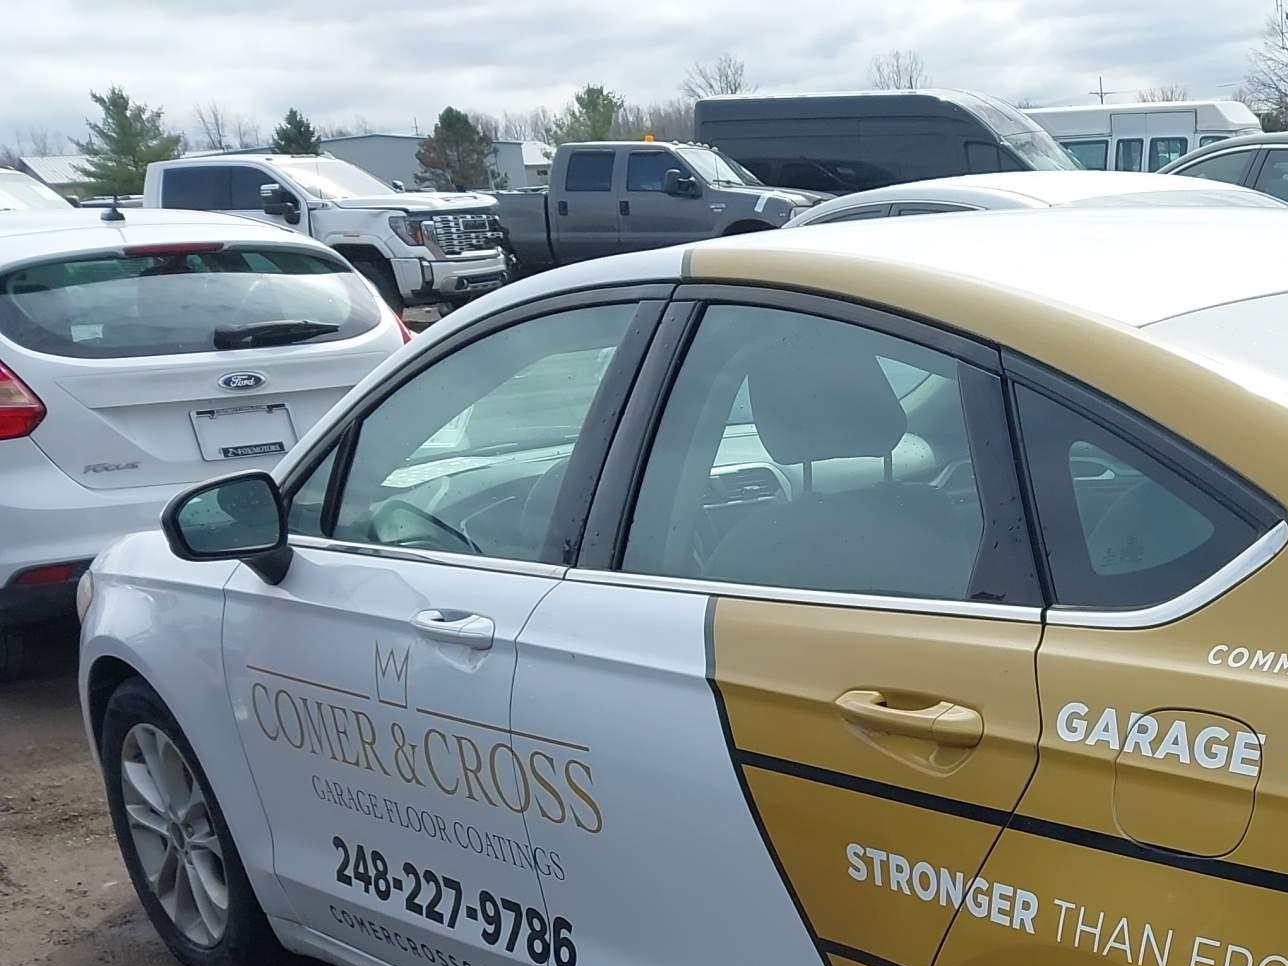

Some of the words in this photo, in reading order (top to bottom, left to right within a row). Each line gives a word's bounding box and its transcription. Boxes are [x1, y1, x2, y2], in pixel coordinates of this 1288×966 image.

[229, 374, 256, 388] Ford
[1056, 701, 1265, 777] GARAGE
[311, 774, 384, 820] GARAGE
[383, 798, 450, 844] FLOOR
[453, 820, 566, 881] COATINGS
[845, 843, 1040, 935] STRONGER
